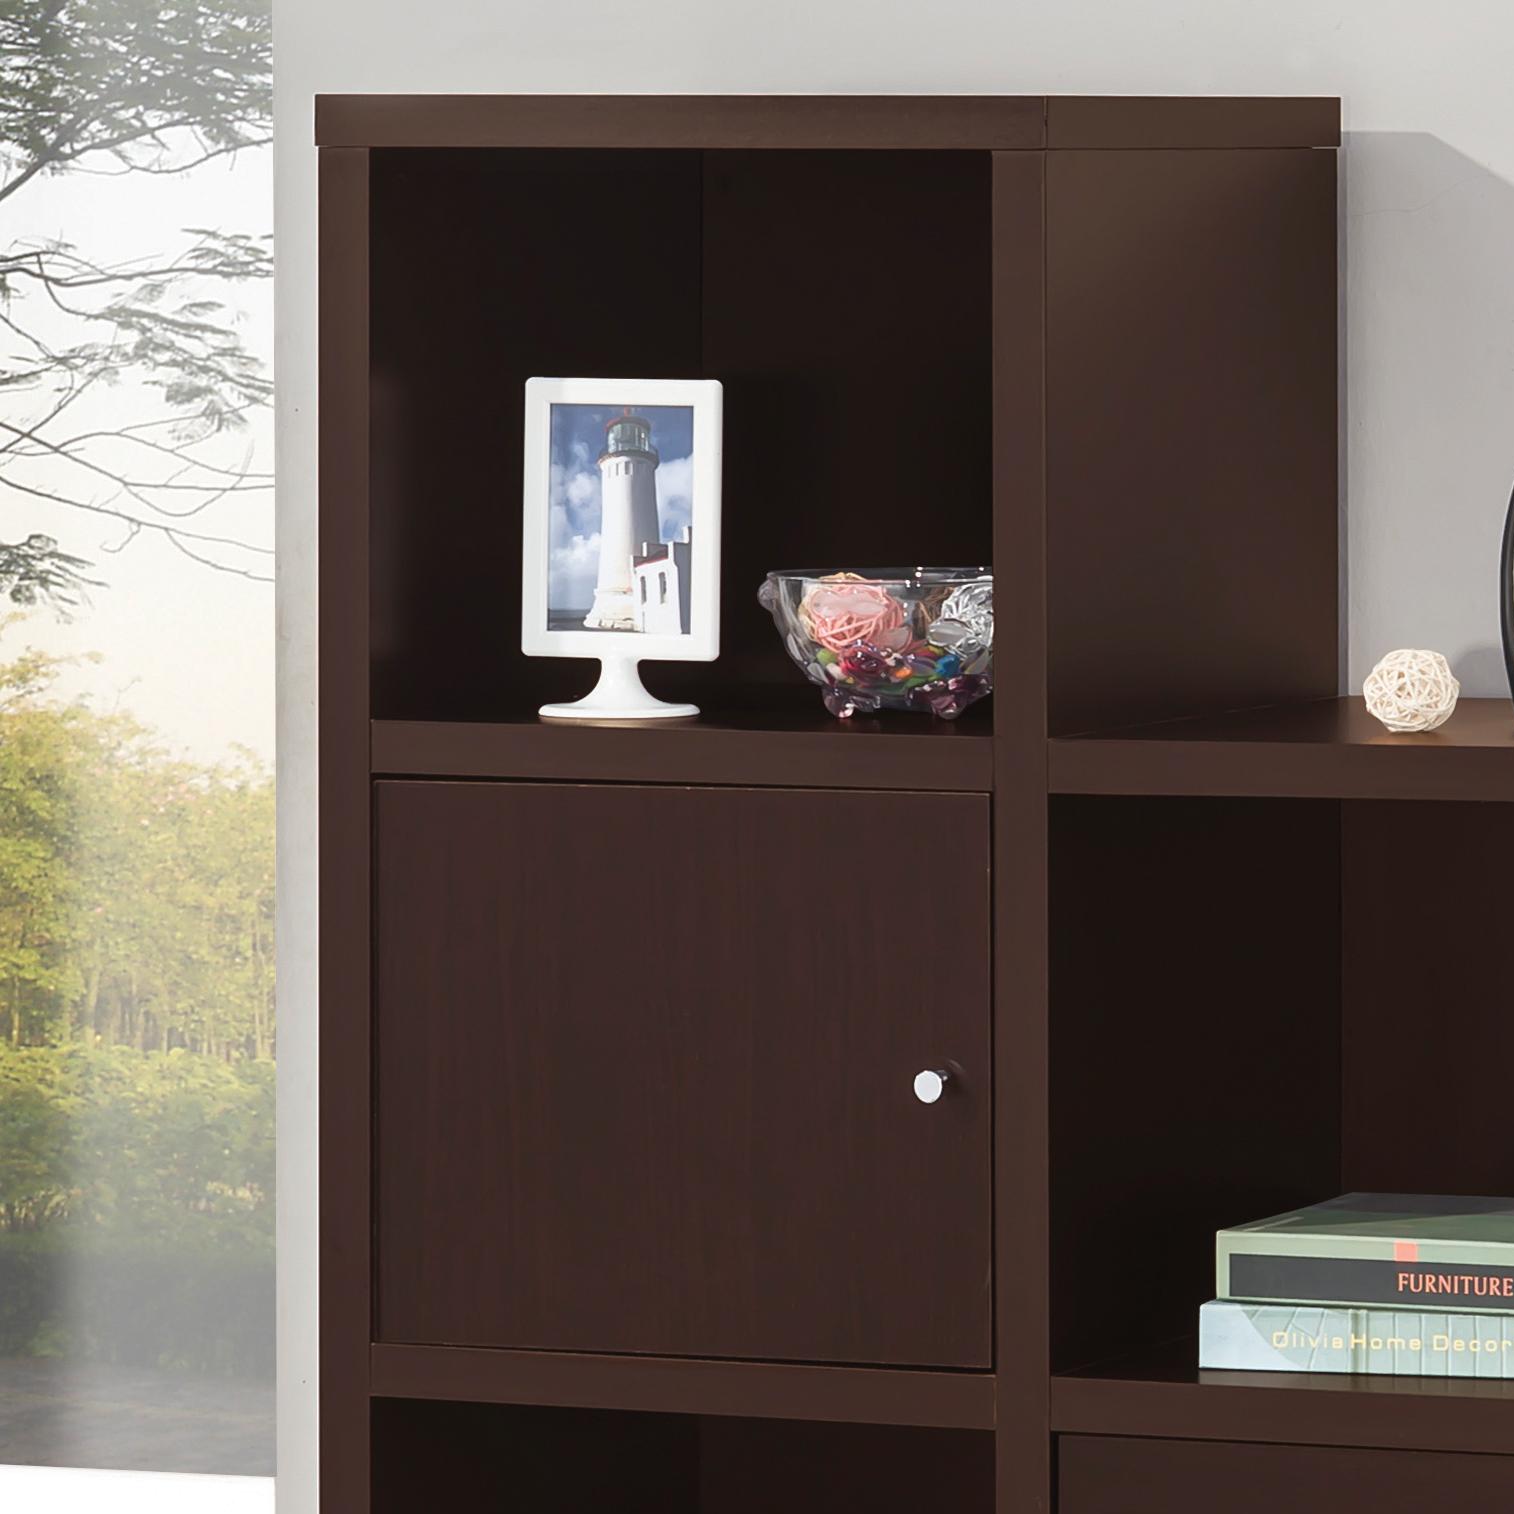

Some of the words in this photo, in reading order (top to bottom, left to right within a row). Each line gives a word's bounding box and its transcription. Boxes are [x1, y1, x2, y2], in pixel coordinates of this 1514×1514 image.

[1397, 1272, 1514, 1297] FURNITURE
[1272, 1331, 1344, 1350] Olivia
[1350, 1333, 1422, 1351] Home
